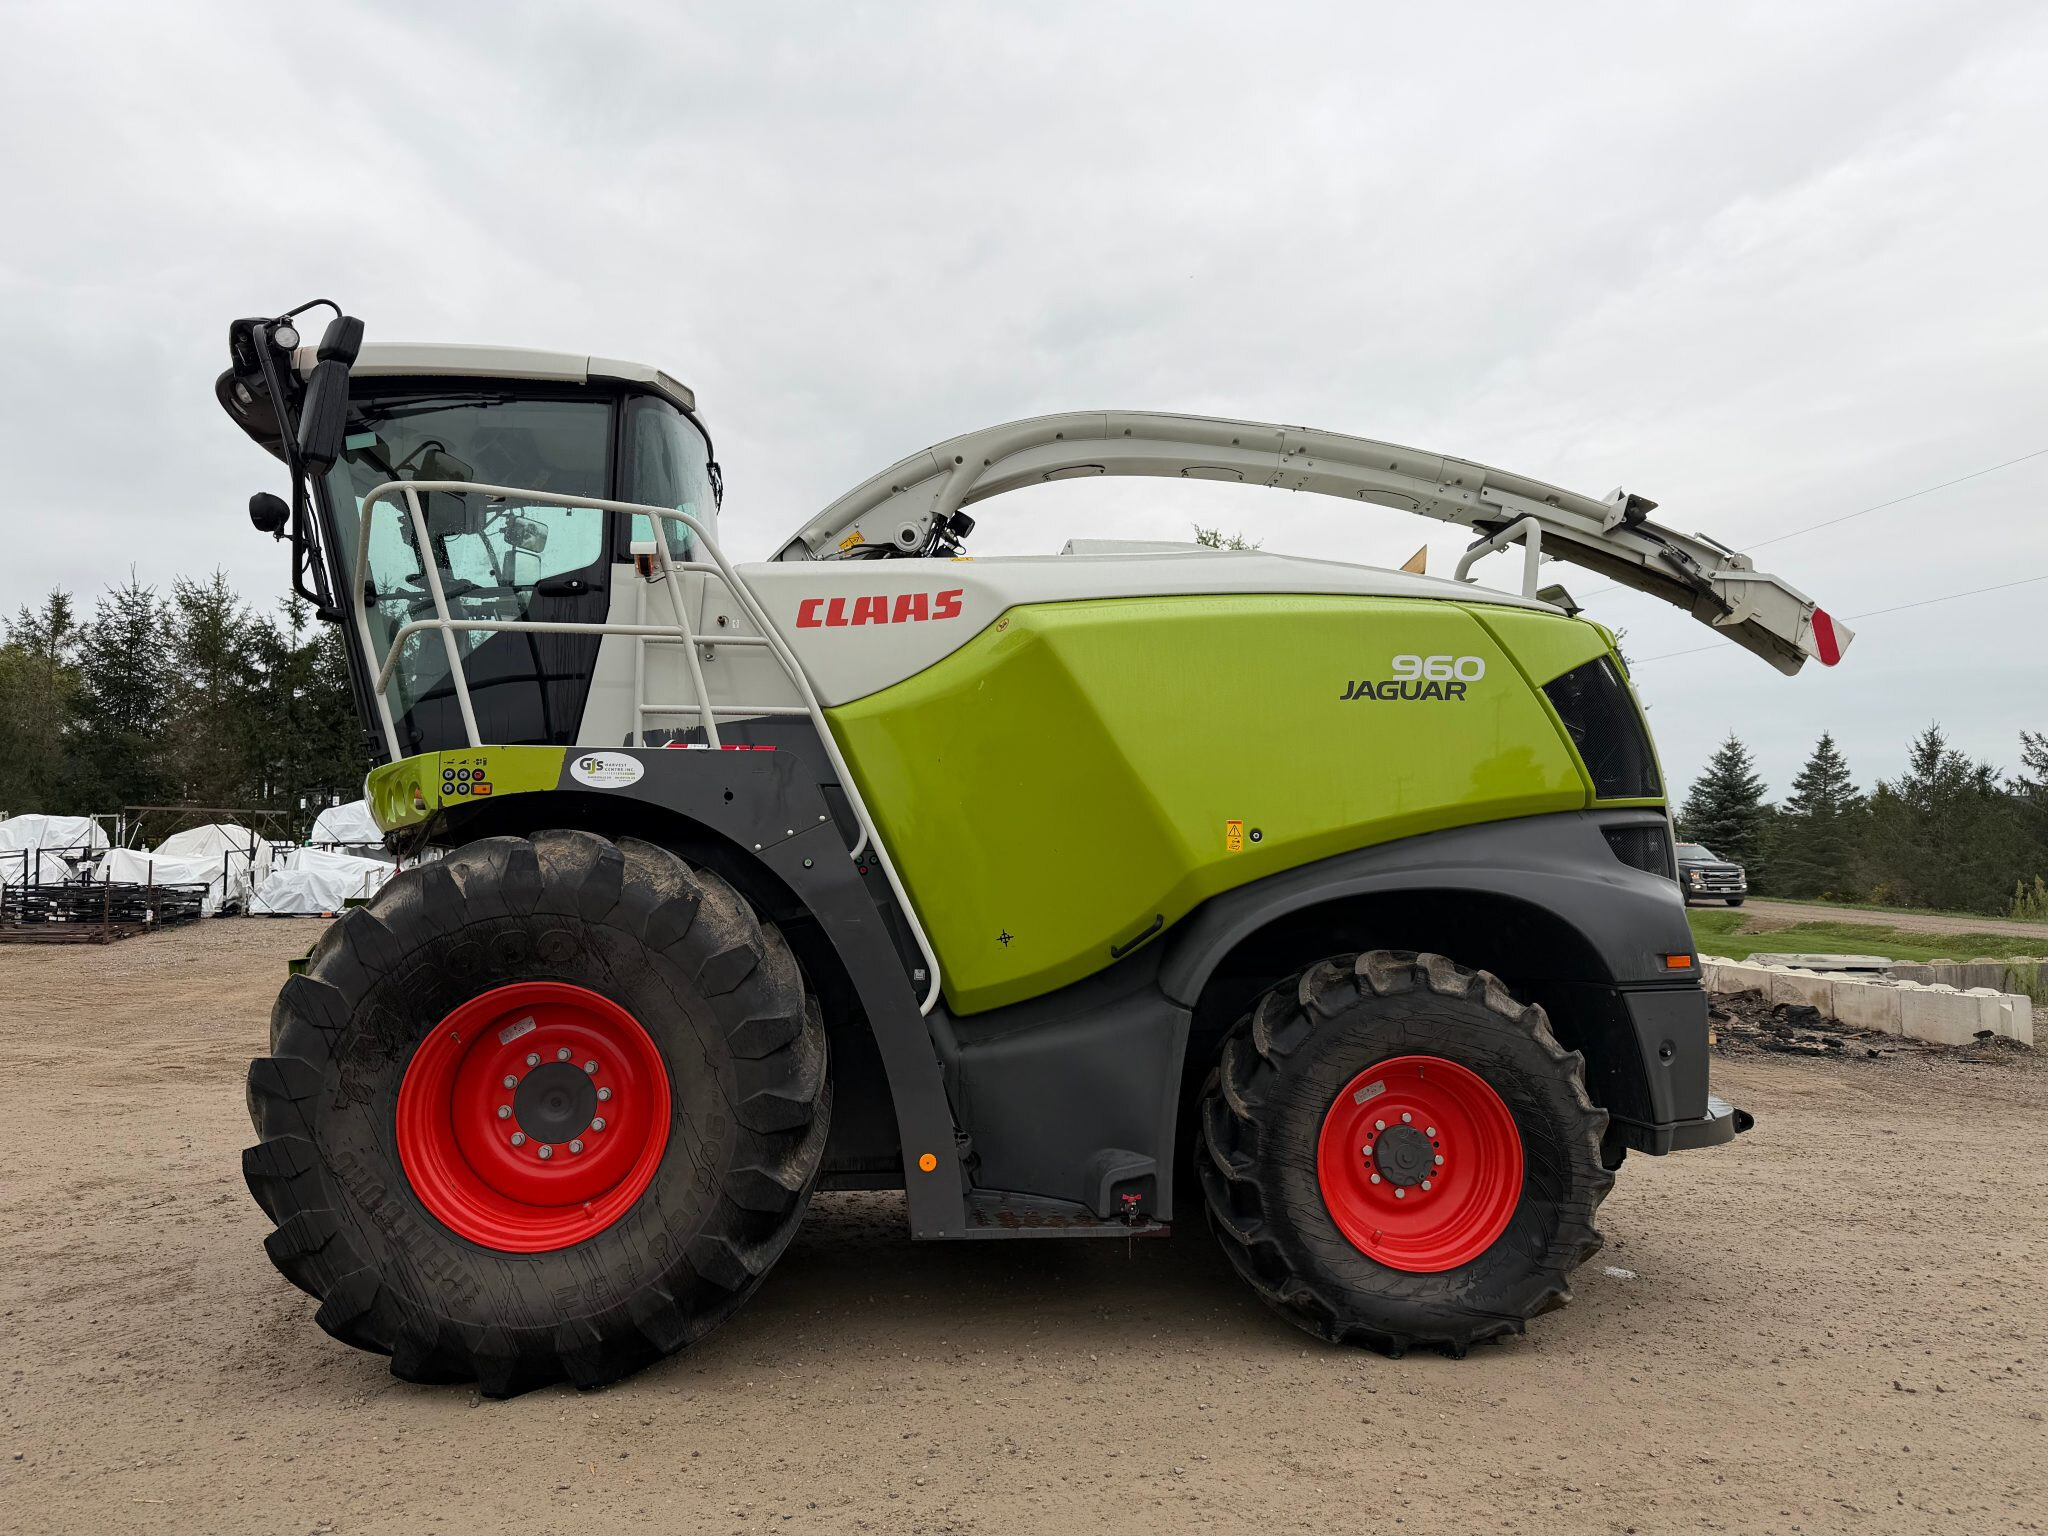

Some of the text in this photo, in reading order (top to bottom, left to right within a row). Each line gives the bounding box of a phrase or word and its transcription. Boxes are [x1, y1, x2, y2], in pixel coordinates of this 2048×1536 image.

[796, 588, 964, 629] CLAAS
[1391, 654, 1486, 682] 960
[1339, 680, 1467, 701] JAGUAR
